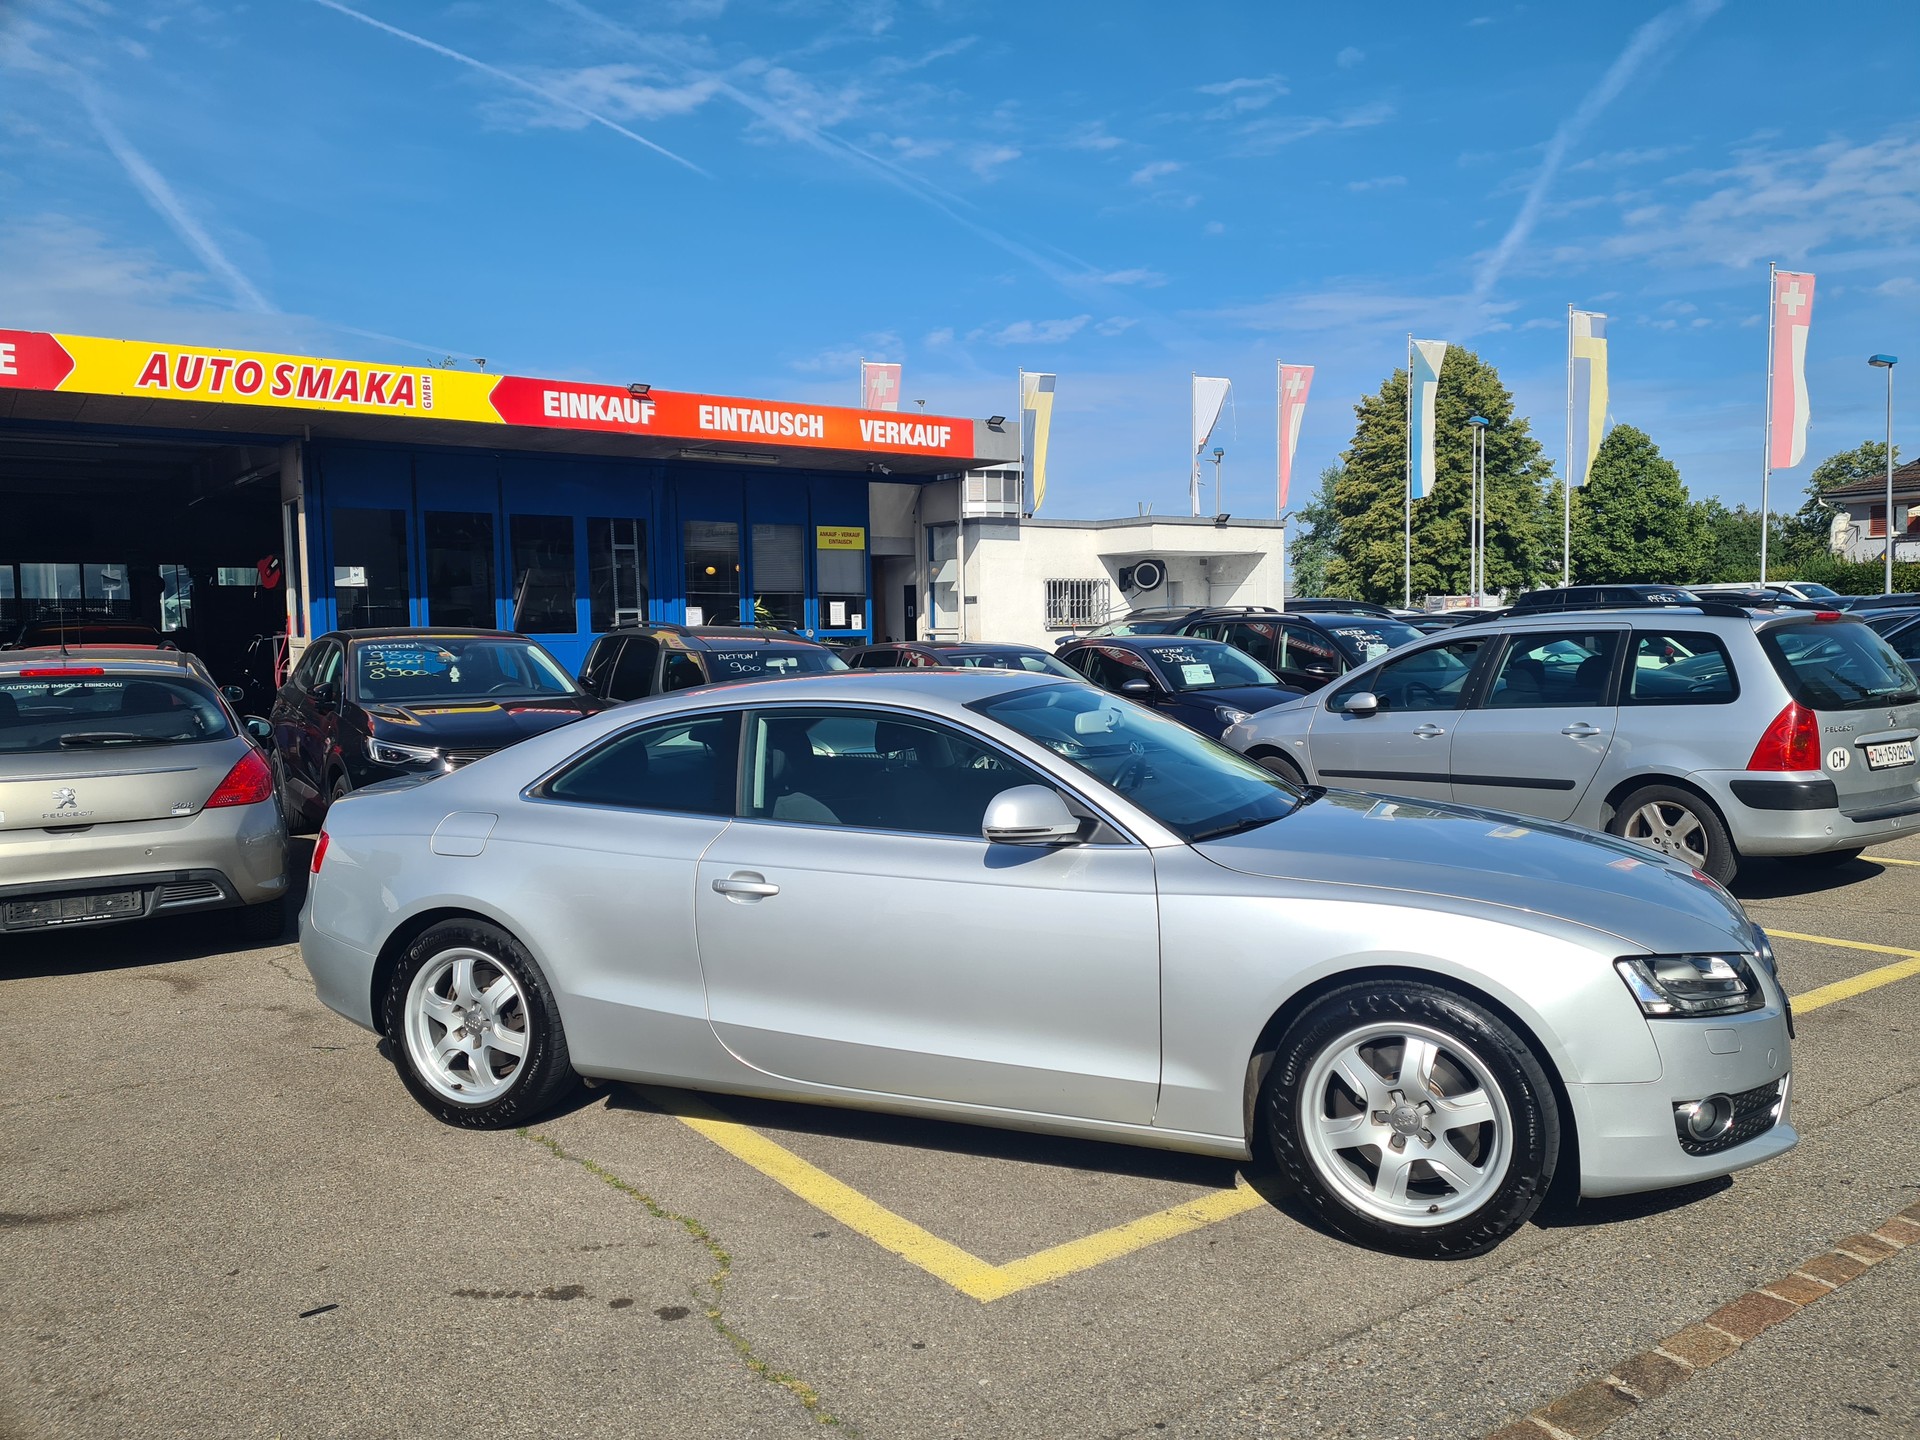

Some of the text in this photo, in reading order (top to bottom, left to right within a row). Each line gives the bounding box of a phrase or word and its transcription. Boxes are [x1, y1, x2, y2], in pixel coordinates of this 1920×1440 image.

[137, 352, 416, 407] AUTO SMAKA
[422, 375, 432, 409] GMBH
[543, 390, 951, 448] EINKAUF EINTAUSCH VERKAUF
[6, 683, 50, 691] AUTOHAUS
[1832, 750, 1846, 769] CH
[42, 810, 95, 819] PEUGEOT
[171, 801, 195, 809] 308
